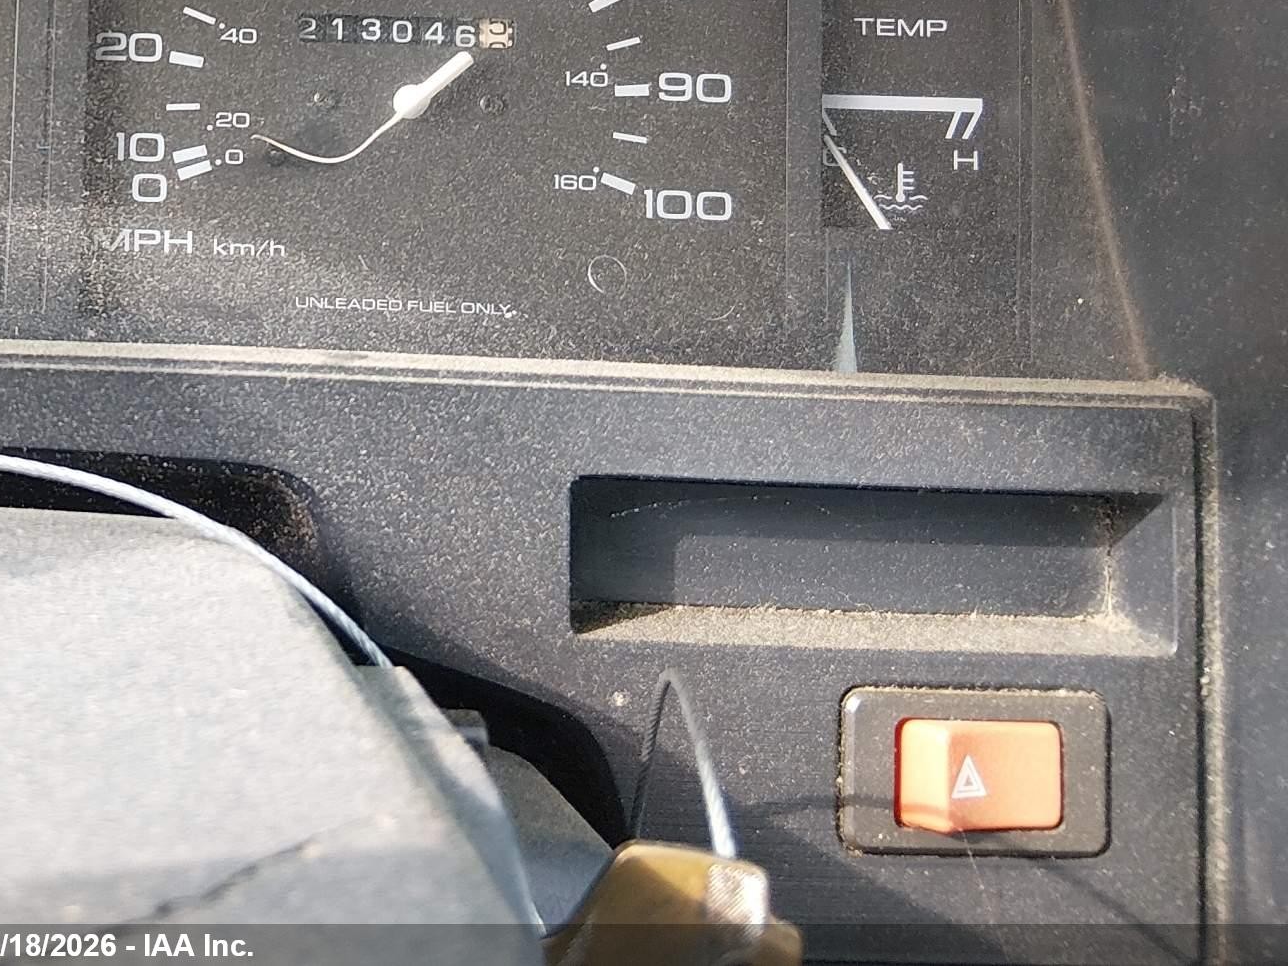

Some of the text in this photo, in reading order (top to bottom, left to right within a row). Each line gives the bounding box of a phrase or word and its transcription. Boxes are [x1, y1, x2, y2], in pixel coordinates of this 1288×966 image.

[220, 28, 258, 44] 40
[853, 17, 948, 37] TEMP
[95, 32, 163, 63] 20
[565, 70, 609, 87] 140
[658, 72, 732, 103] 90
[215, 112, 250, 128] 20
[116, 132, 165, 162] 10
[225, 149, 244, 165] 0
[953, 148, 979, 170] H
[132, 173, 167, 202] 0
[554, 174, 597, 191] 160
[644, 188, 732, 221] 100
[213, 237, 286, 258] km/h
[295, 296, 403, 312] UNLEADED
[407, 300, 457, 314] FUEL
